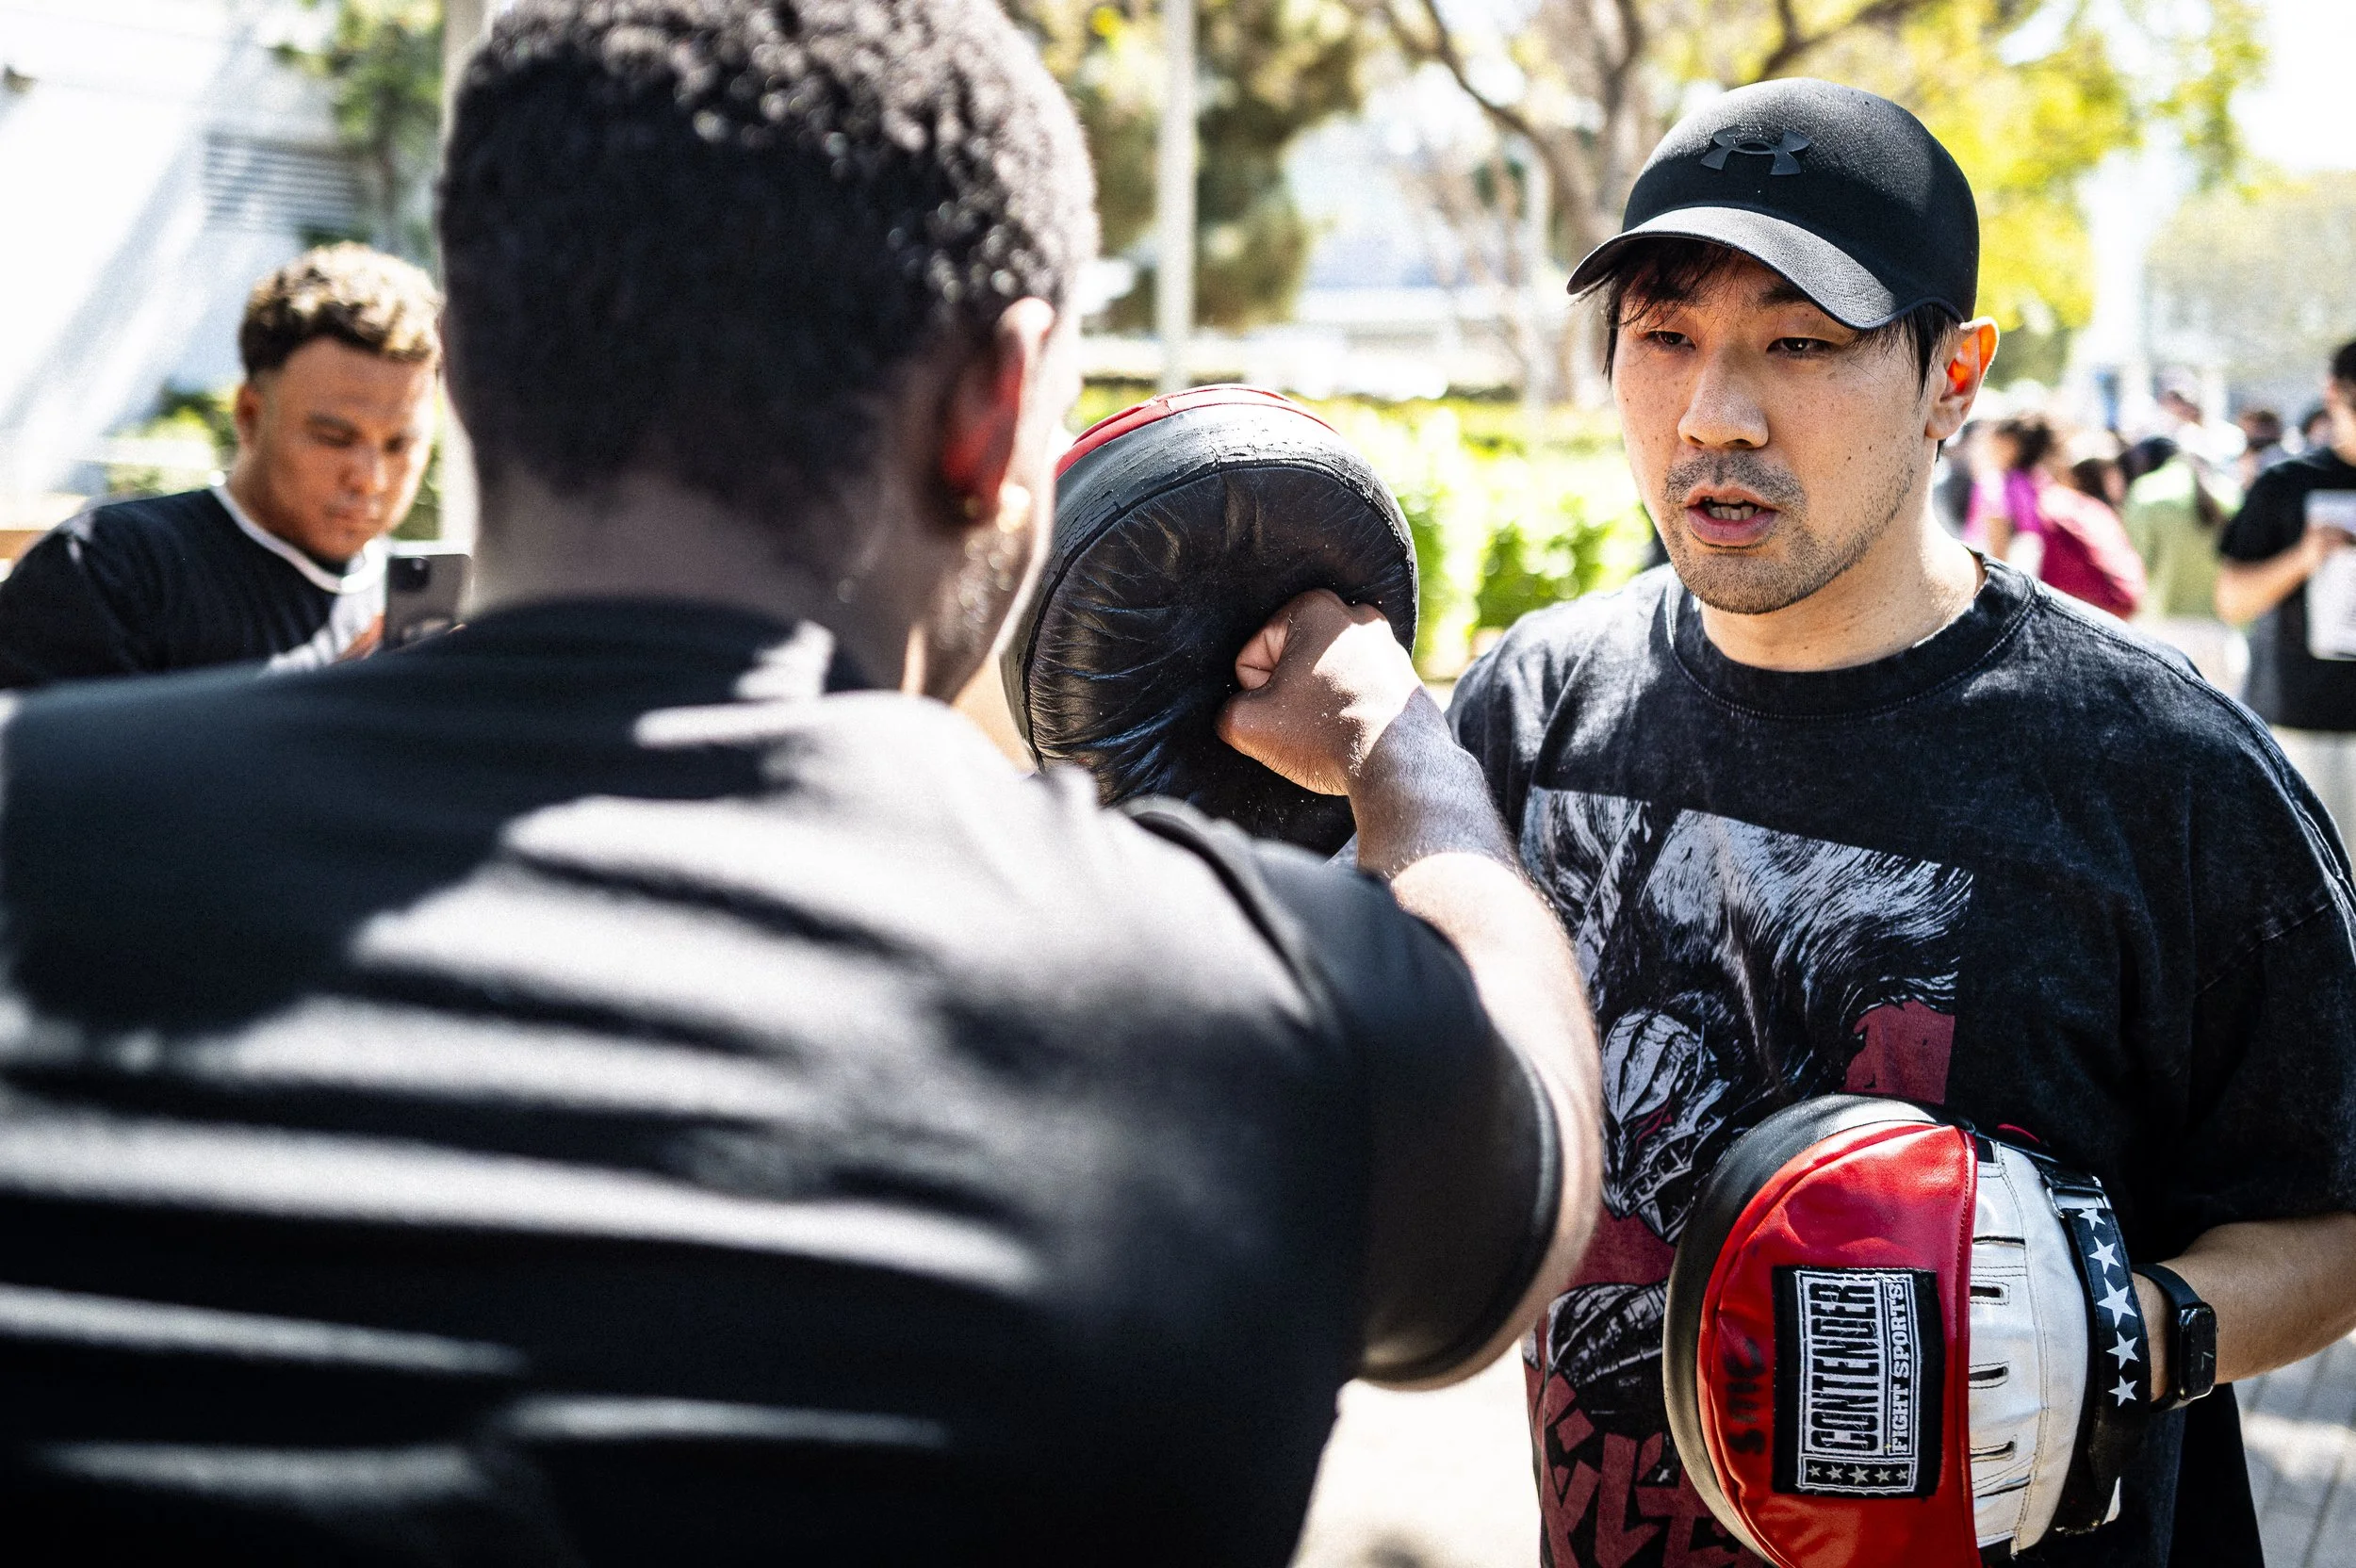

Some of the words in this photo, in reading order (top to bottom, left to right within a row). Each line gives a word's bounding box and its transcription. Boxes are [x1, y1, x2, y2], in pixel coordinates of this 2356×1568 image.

[1808, 1282, 1879, 1452] CONTENDER
[1888, 1282, 1910, 1379] SPORTS
[1891, 1383, 1909, 1454] FIGHT
